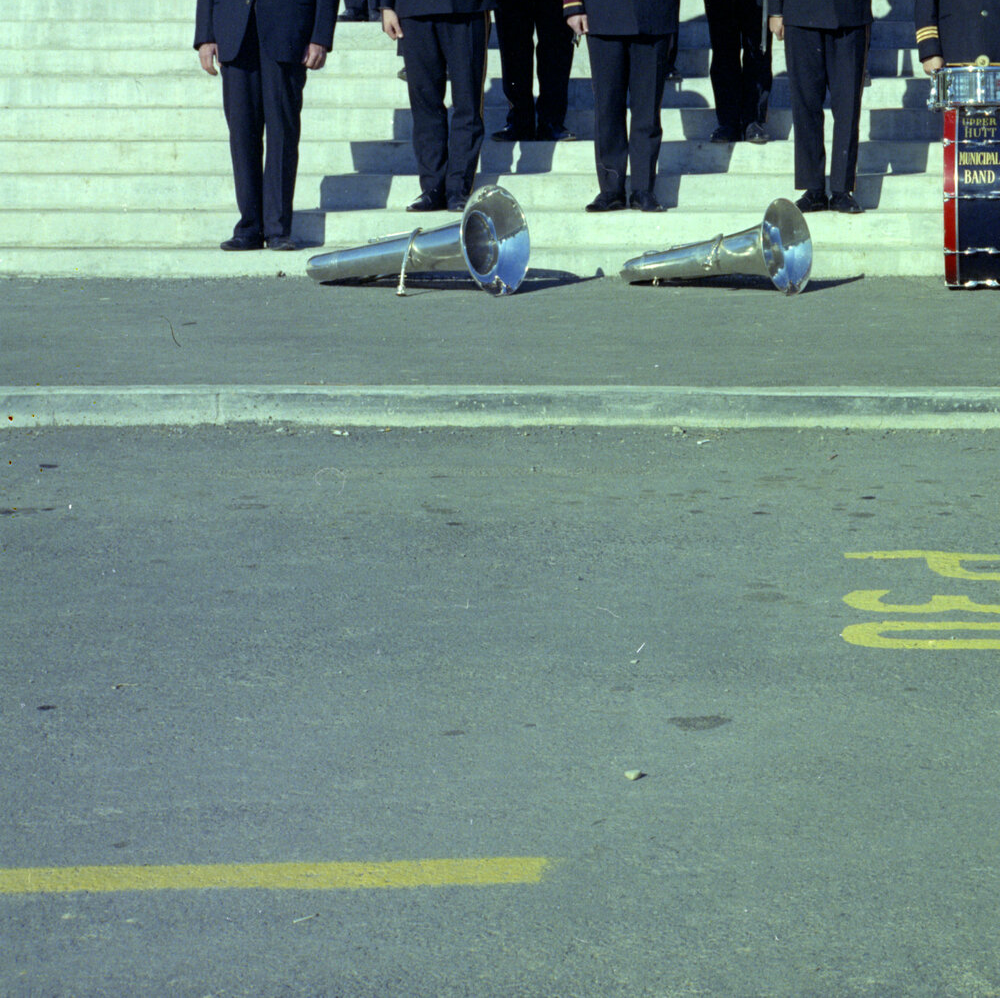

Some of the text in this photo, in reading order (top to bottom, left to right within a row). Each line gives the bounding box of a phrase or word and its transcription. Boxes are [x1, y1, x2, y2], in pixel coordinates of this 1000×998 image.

[962, 117, 997, 126] UPPER
[964, 127, 997, 138] HUTT
[964, 169, 995, 184] BAND
